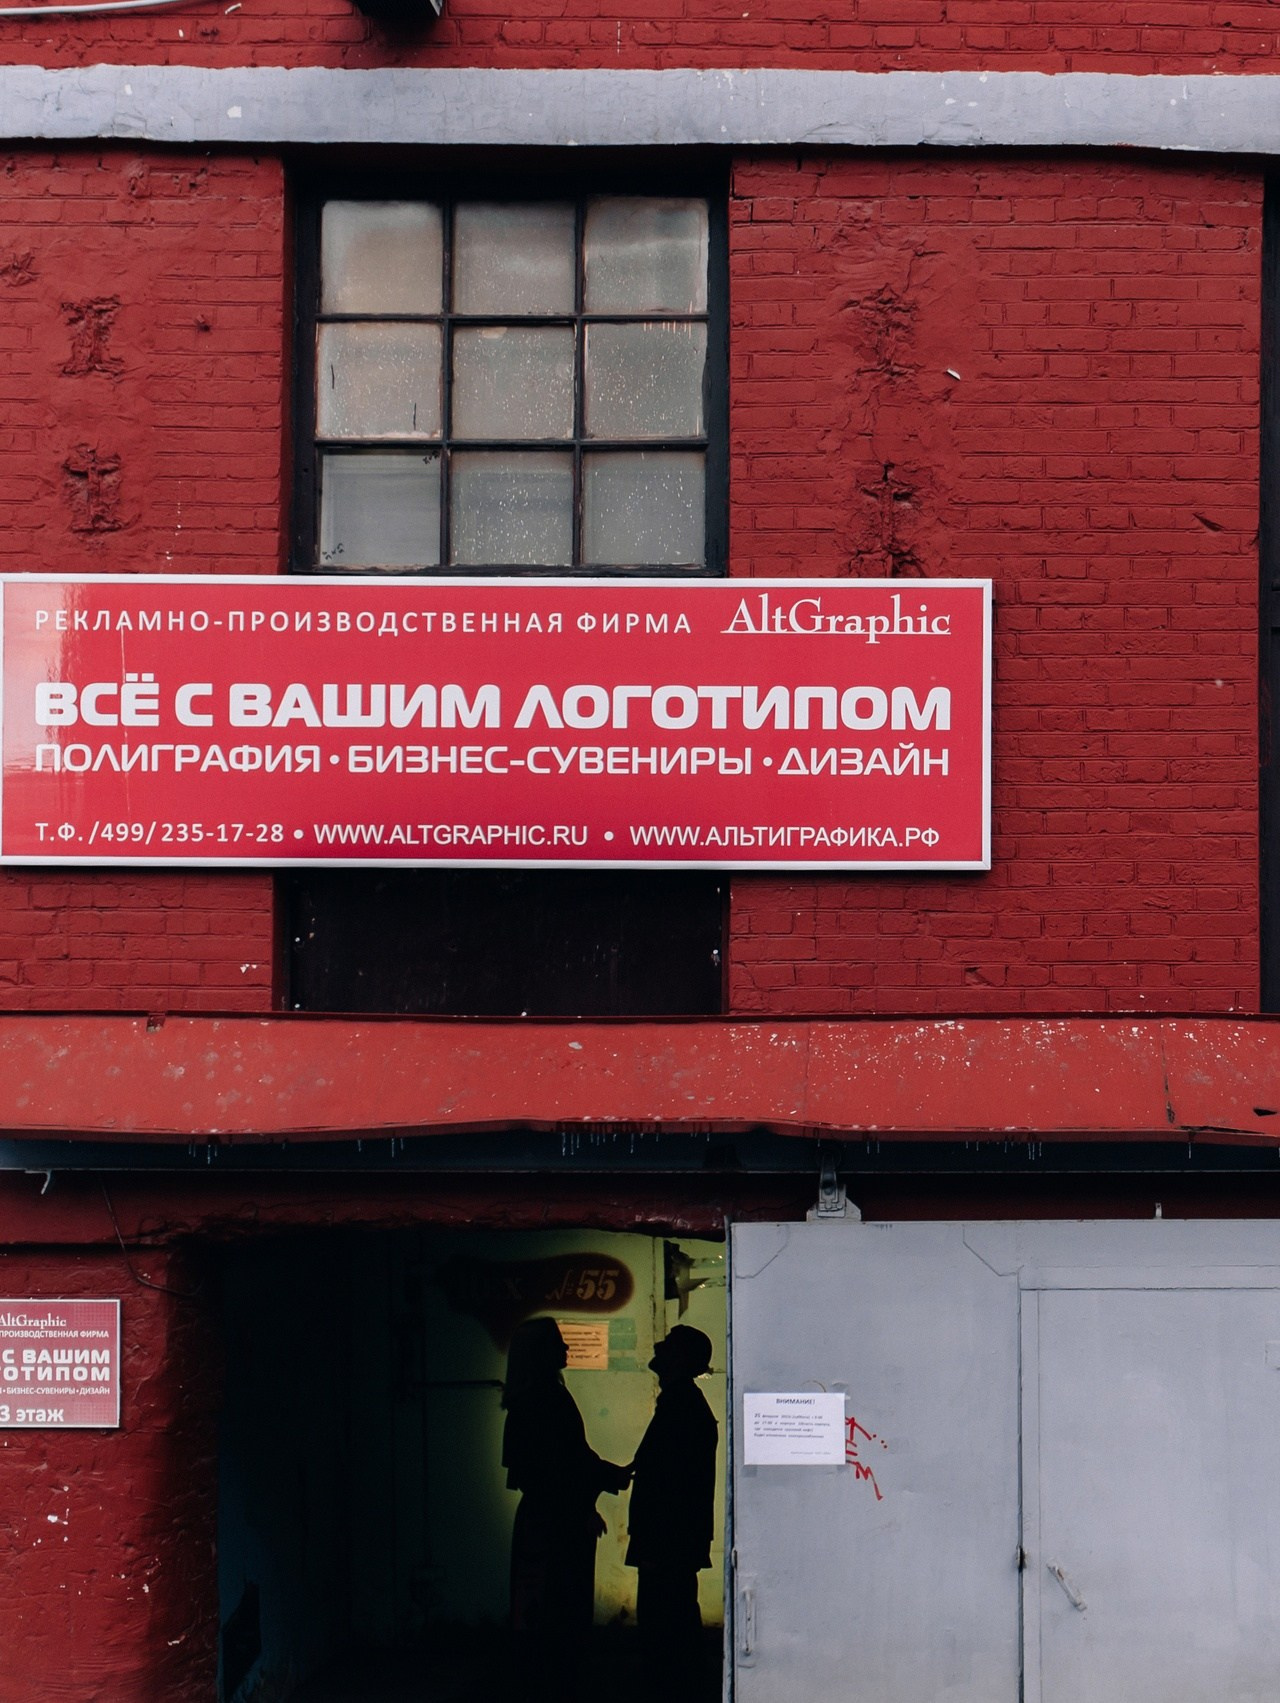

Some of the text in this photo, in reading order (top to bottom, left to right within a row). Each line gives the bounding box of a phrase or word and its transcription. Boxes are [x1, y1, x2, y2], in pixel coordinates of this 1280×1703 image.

[35, 609, 691, 637] РЕКЛАМНО-ПРОИЗВОДСТВЕННАЯ ФИРМА
[720, 592, 951, 644] AltGraphic
[35, 673, 951, 730] ВСЁ С ВАШИМ ЛОГОТИПОМ
[35, 742, 949, 776] ПОЛИГРАФИЯ БИЗНЕС-СУВЕНИРЫ ДИЗАЙН
[313, 824, 588, 846] WWW.ALTGRAPHIC.RU
[629, 826, 940, 848] WWW.АЛЬТИГРАФИКА.РФ
[0, 1312, 67, 1329] AltGraphic
[79, 1330, 109, 1338] ФИРМА
[2, 1349, 110, 1364] С ВАШИМ
[0, 1366, 110, 1382] ОТИПОМ
[6, 1386, 76, 1395] БИЗНЕС-СУВЕНИРЫ
[79, 1386, 110, 1396] ДИЗАЙН
[16, 1408, 64, 1422] этаж
